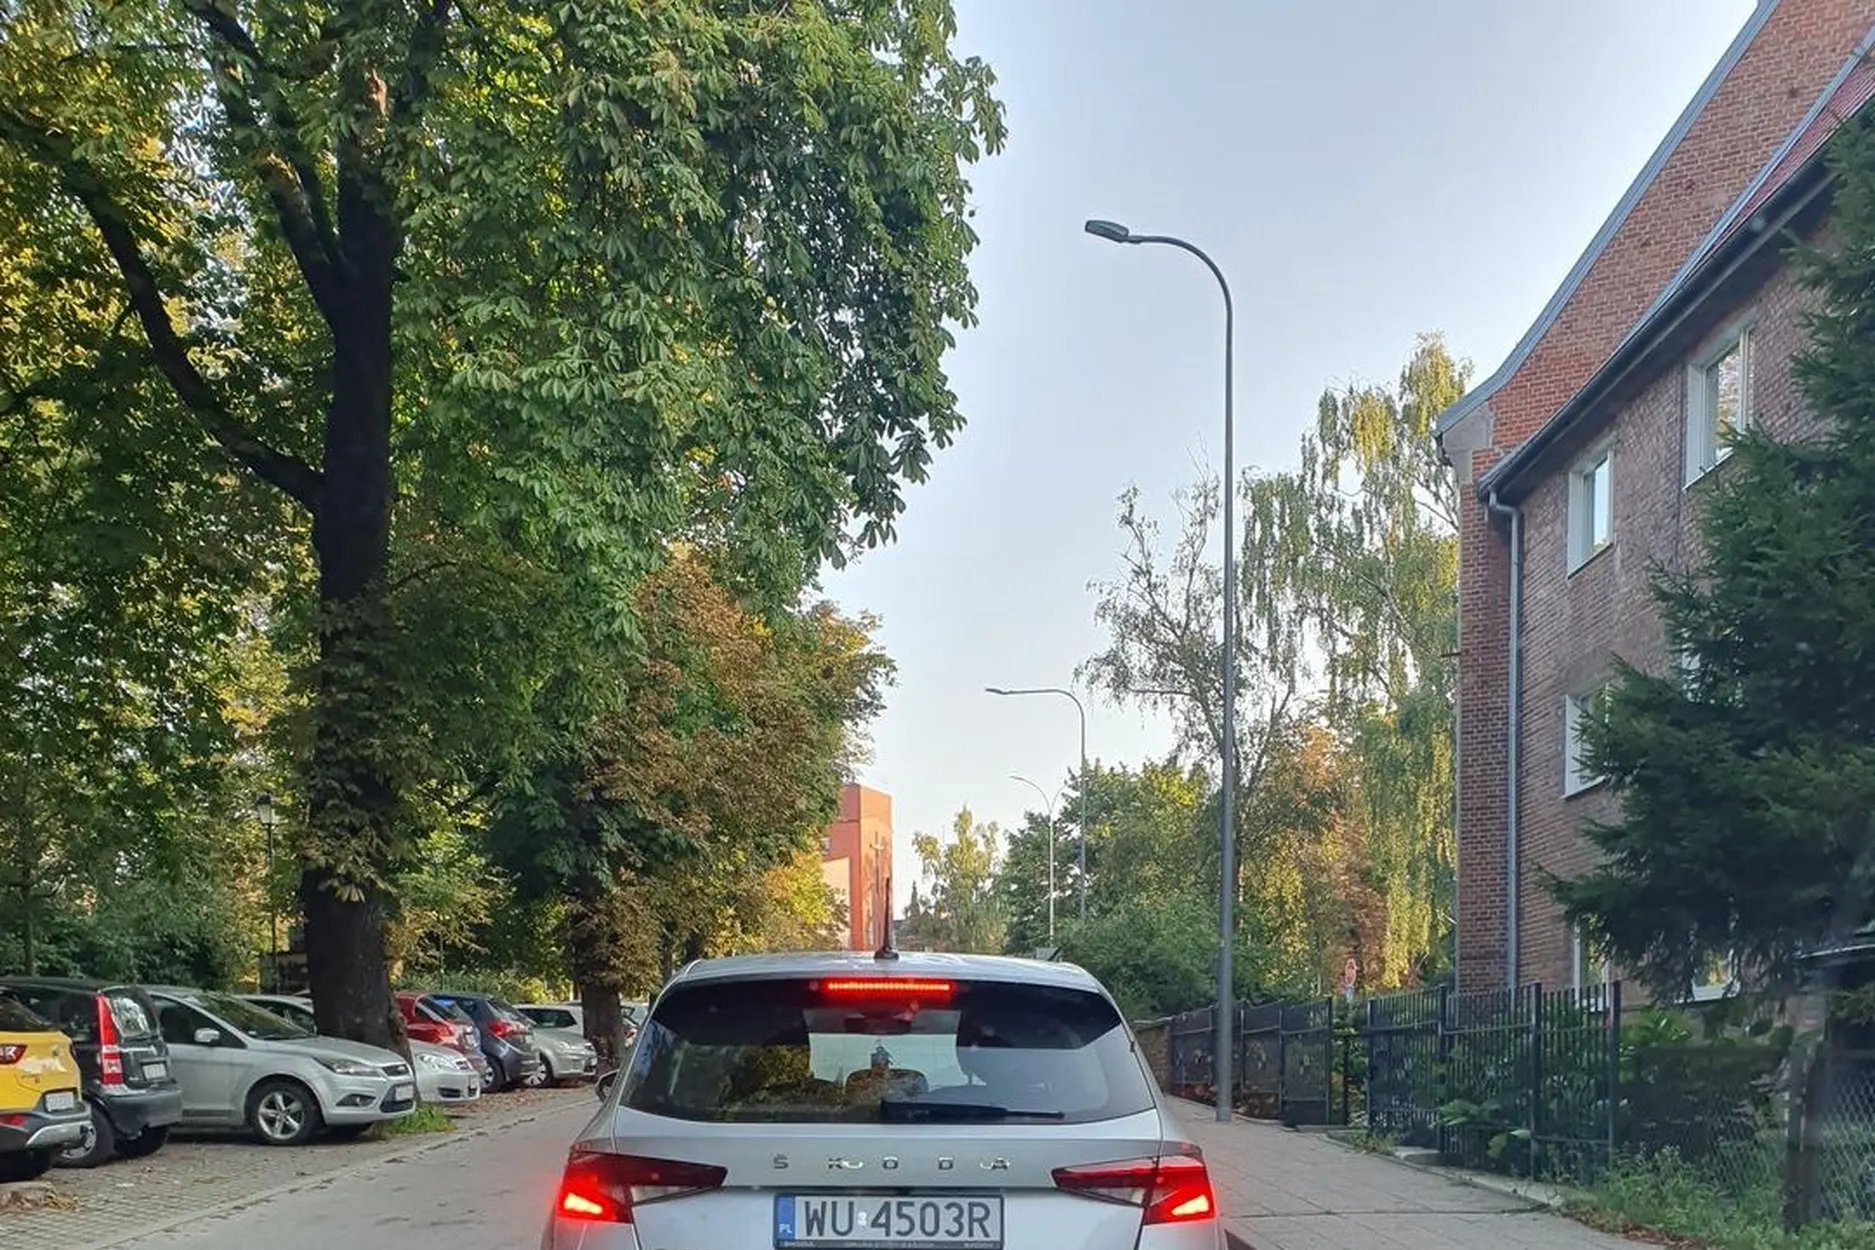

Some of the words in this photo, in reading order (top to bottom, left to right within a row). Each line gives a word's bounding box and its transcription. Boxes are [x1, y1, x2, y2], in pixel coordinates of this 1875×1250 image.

[779, 1223, 793, 1234] PL
[805, 1200, 854, 1237] WU
[870, 1201, 992, 1238] 4503R
